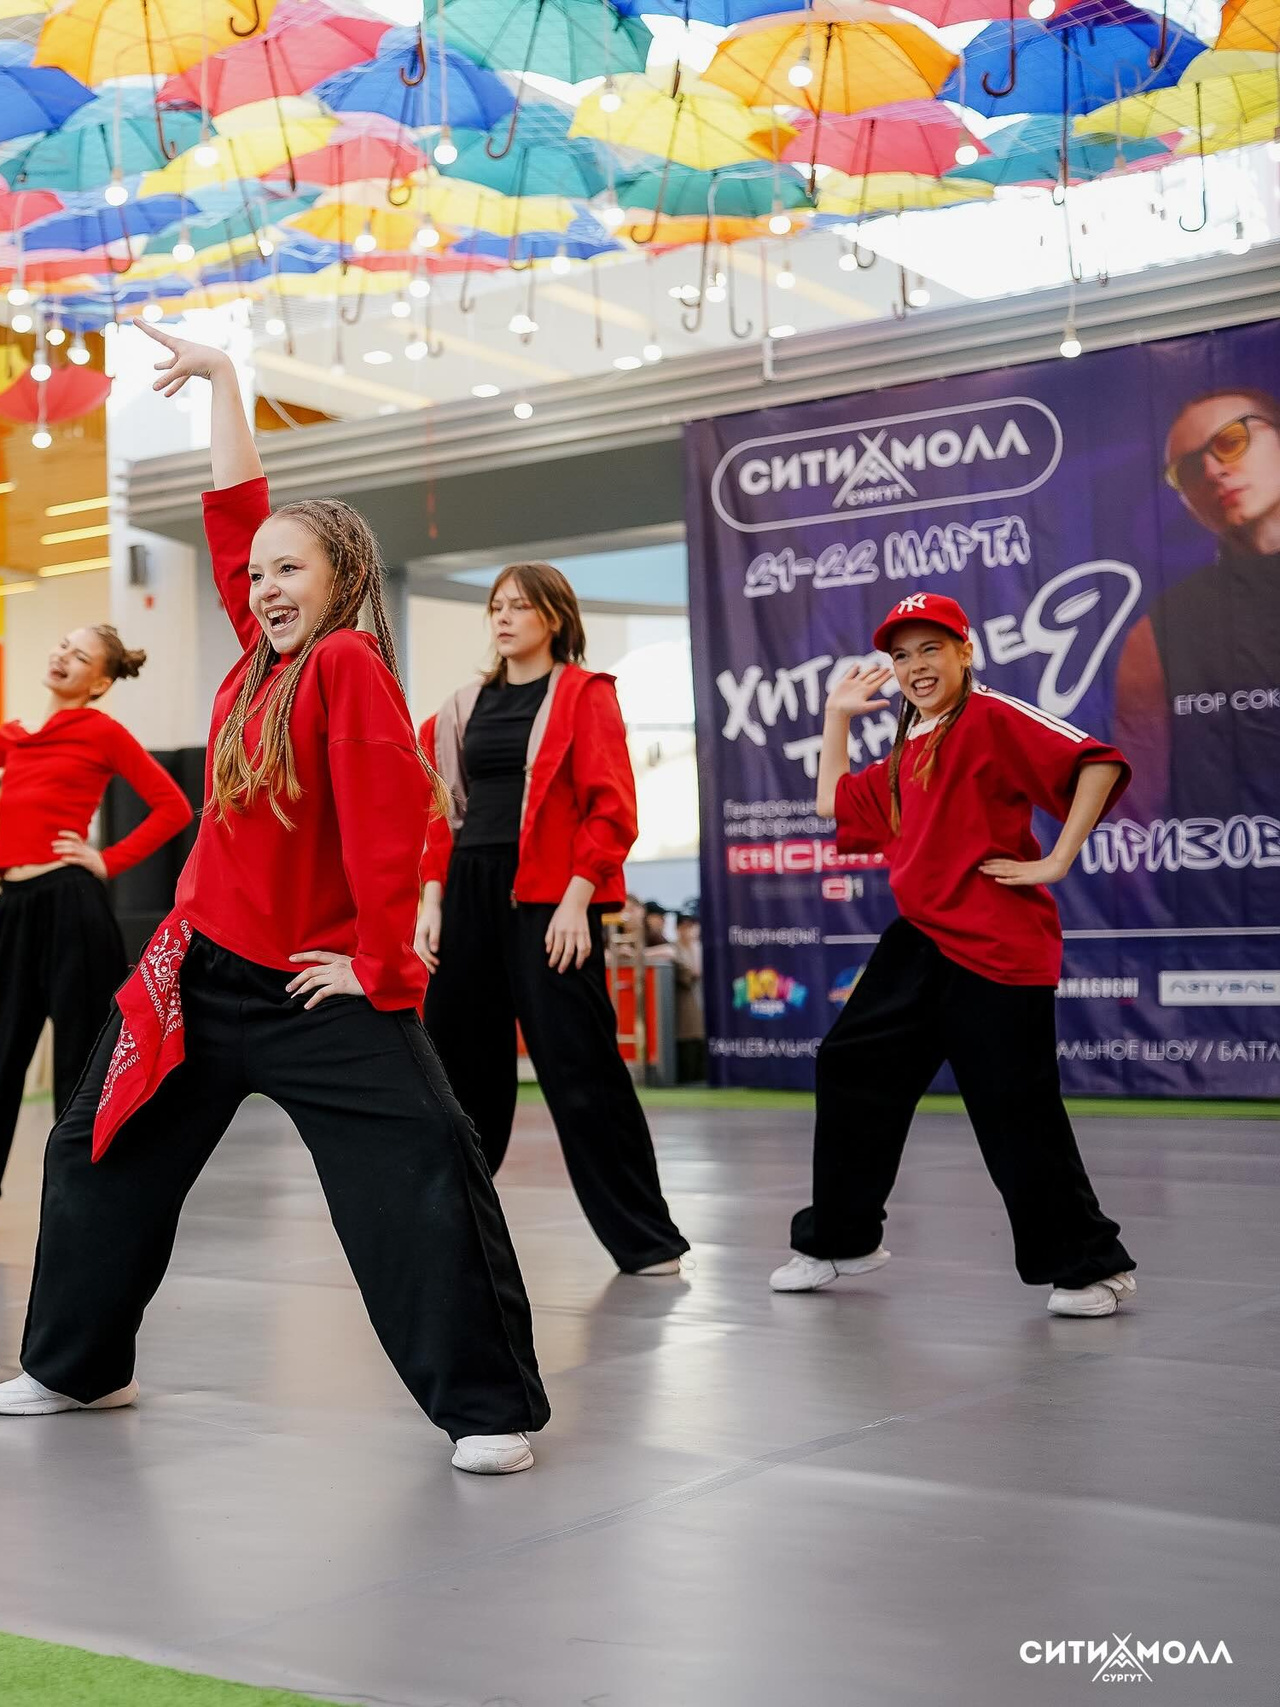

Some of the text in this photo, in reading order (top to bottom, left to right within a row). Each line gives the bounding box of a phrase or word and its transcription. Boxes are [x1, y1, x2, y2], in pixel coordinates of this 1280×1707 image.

[738, 419, 1031, 496] СИТИ МОЛЛ
[743, 515, 1031, 598] 21-22 МАРТА
[1174, 691, 1227, 716] ЕГОР
[1143, 1039, 1197, 1061] ШОУ
